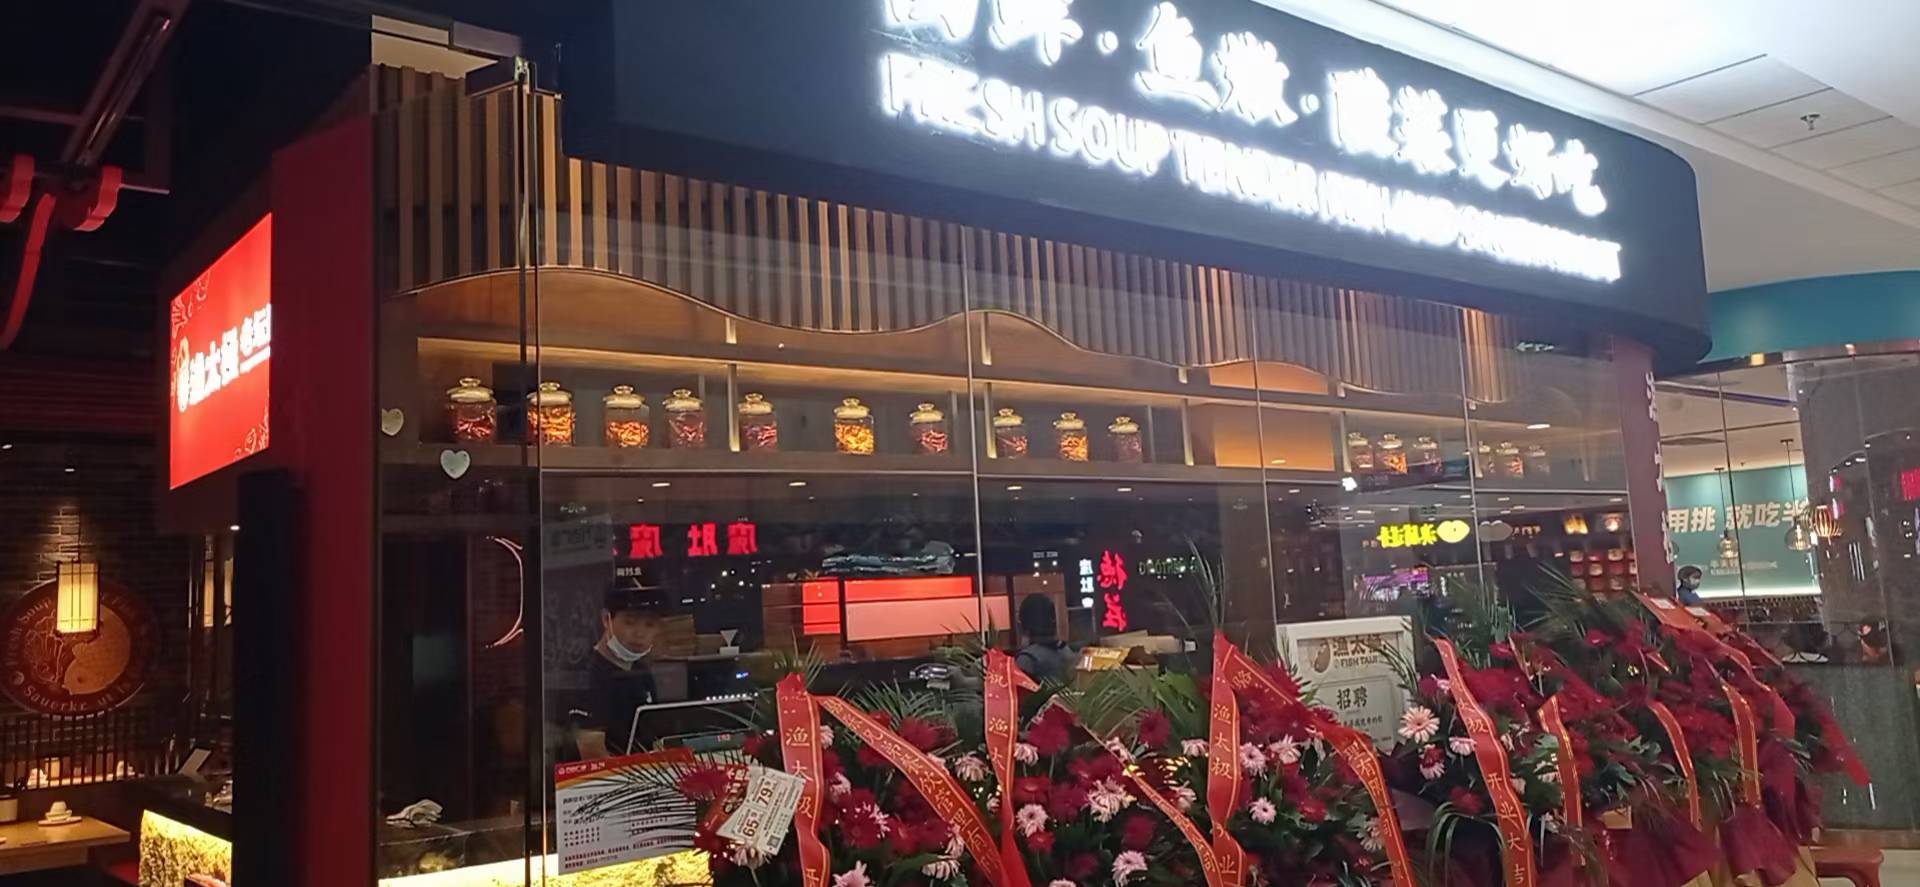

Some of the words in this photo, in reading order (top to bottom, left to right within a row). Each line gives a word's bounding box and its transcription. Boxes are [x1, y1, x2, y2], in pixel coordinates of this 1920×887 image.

[882, 53, 1045, 145] FRESH
[1050, 97, 1168, 175] SOUP
[1211, 703, 1233, 780] 渔太极
[1336, 685, 1368, 710] 招聘
[1488, 772, 1525, 884] 开业大吉
